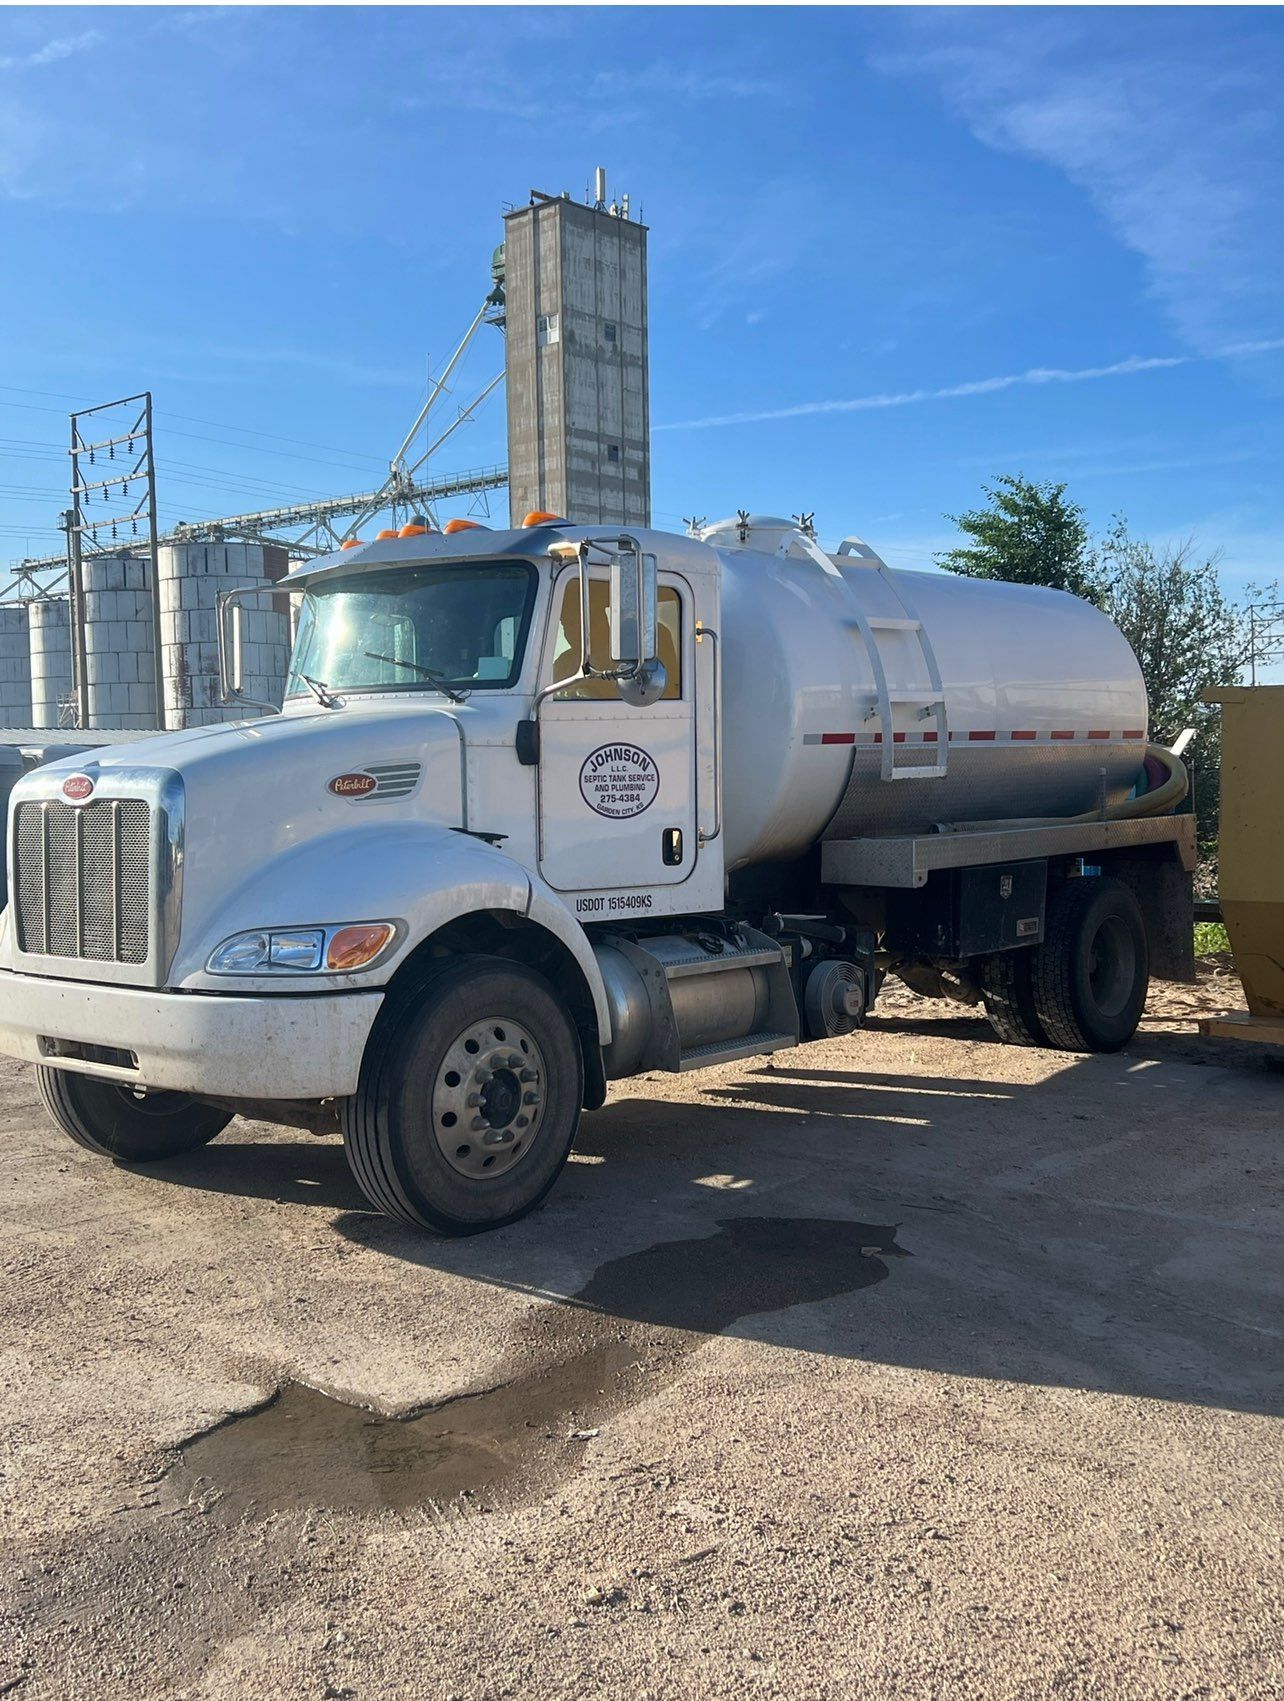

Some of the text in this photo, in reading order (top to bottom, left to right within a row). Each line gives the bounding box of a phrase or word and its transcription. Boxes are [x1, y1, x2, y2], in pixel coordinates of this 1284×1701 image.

[590, 748, 650, 773] JOHNSON
[335, 778, 372, 792] Peterbilt
[584, 774, 655, 783] SEPTIC TANK SERVICE
[600, 794, 640, 803] 275-4384
[596, 803, 620, 815] GARDEN
[576, 895, 652, 912] USDOT 1515409KS
